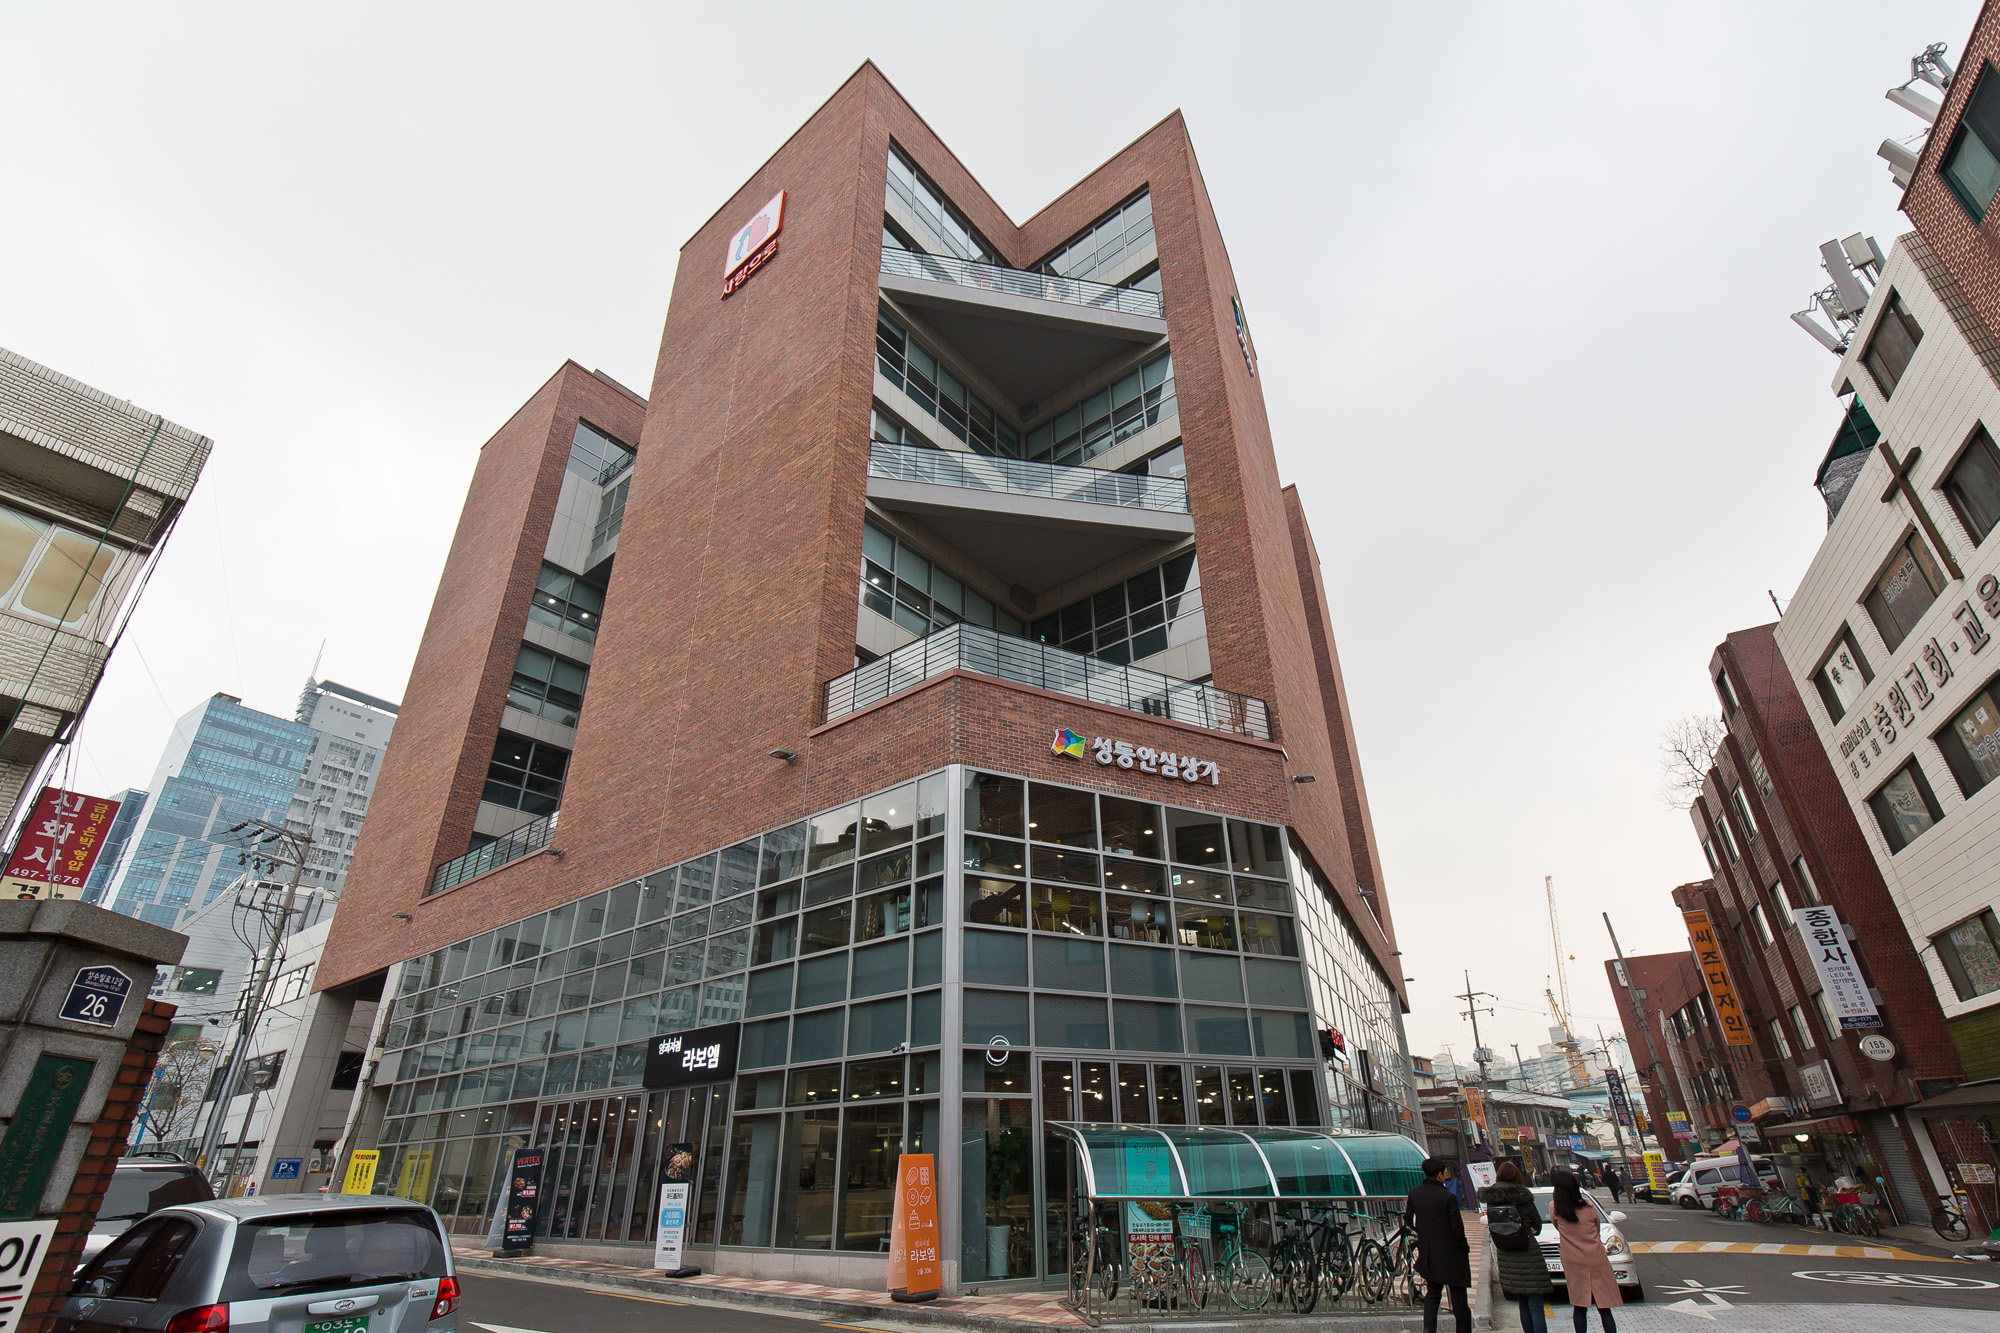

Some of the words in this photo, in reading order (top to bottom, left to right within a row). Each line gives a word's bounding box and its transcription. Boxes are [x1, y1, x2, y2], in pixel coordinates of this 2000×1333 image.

[720, 239, 778, 300] 사랑으로
[1885, 559, 1915, 601] 비전센터
[1092, 737, 1220, 785] 성동안심상가
[1805, 909, 1847, 964] 종합사
[80, 994, 108, 1018] 26
[682, 1044, 720, 1071] 라보엠
[278, 1163, 288, 1172] P
[517, 1156, 540, 1165] VERTEX
[911, 1247, 935, 1263] 라보엠
[1826, 1272, 1958, 1287] 30
[321, 1319, 353, 1331] 03노
